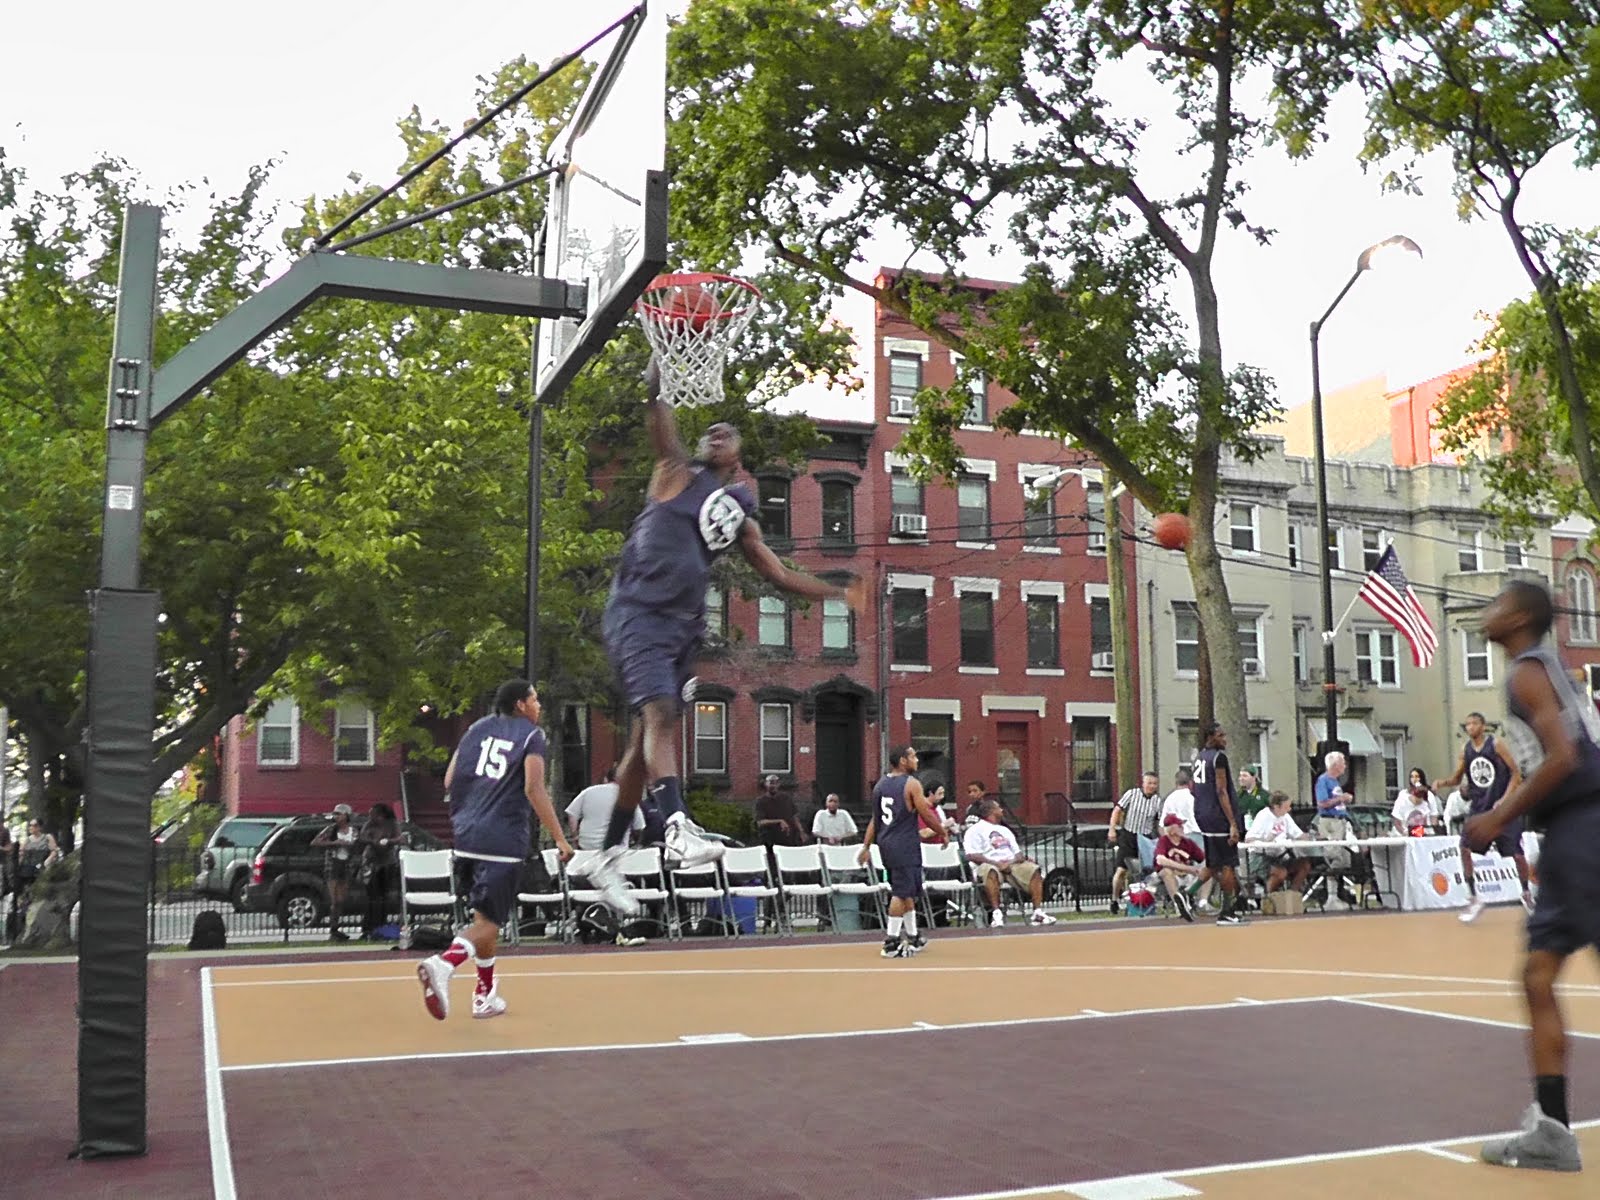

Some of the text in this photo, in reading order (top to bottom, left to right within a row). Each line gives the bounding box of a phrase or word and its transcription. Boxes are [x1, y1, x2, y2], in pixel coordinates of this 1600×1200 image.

[475, 735, 515, 780] 15
[1193, 759, 1206, 784] 21
[880, 796, 894, 825] 5
[1454, 867, 1519, 885] BKETBALL
